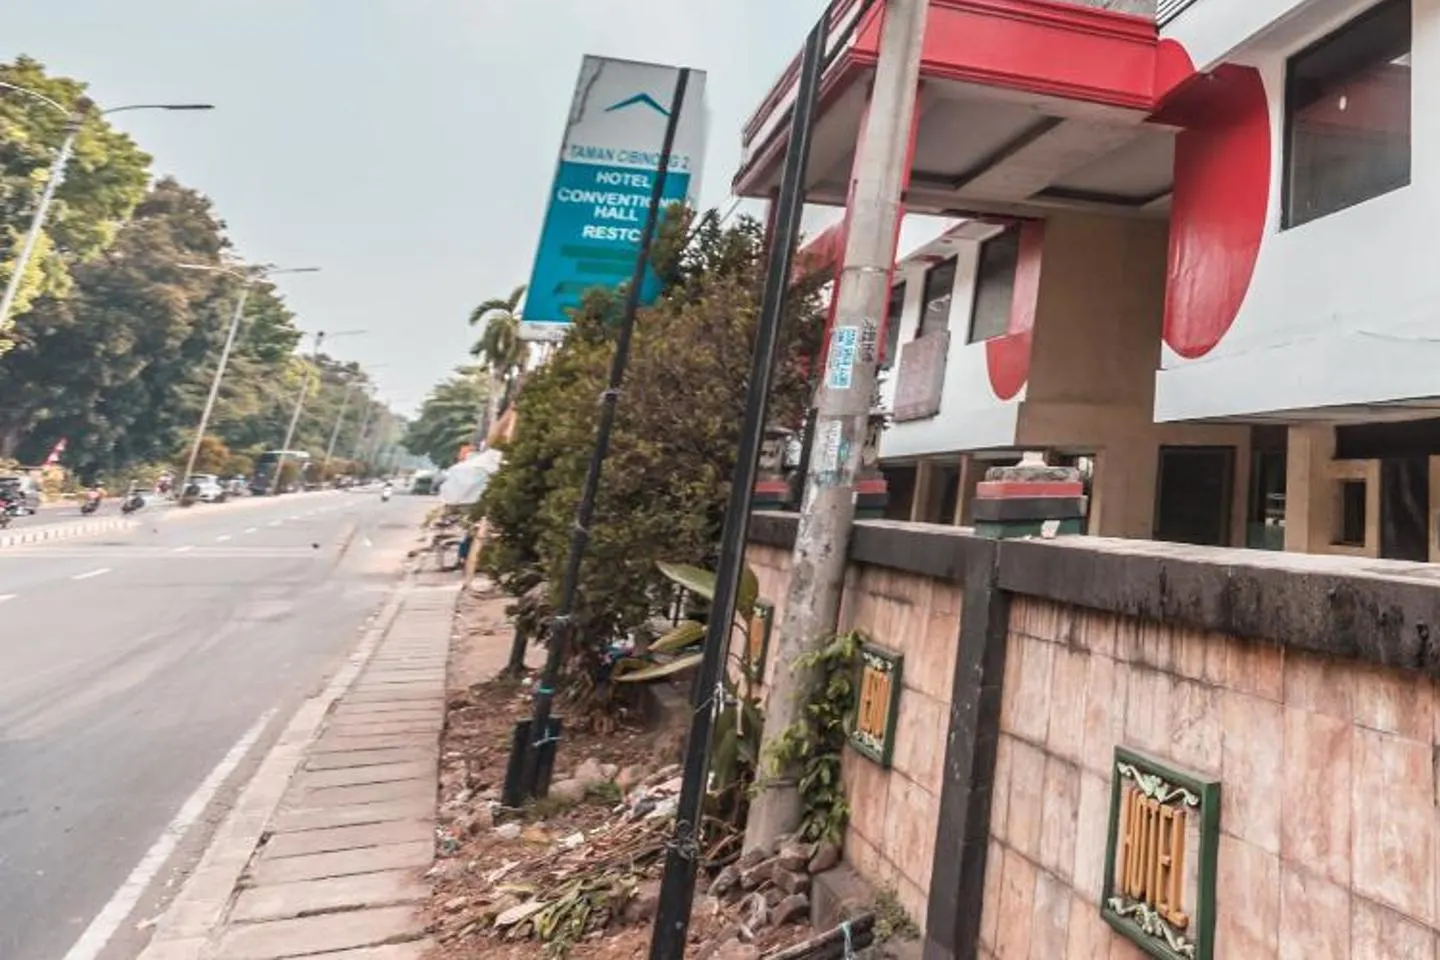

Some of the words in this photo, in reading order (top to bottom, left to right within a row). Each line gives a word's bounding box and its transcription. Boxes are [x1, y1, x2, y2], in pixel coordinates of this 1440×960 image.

[571, 144, 615, 160] TAMAN
[596, 171, 652, 188] HOTEL
[594, 205, 639, 221] HALL
